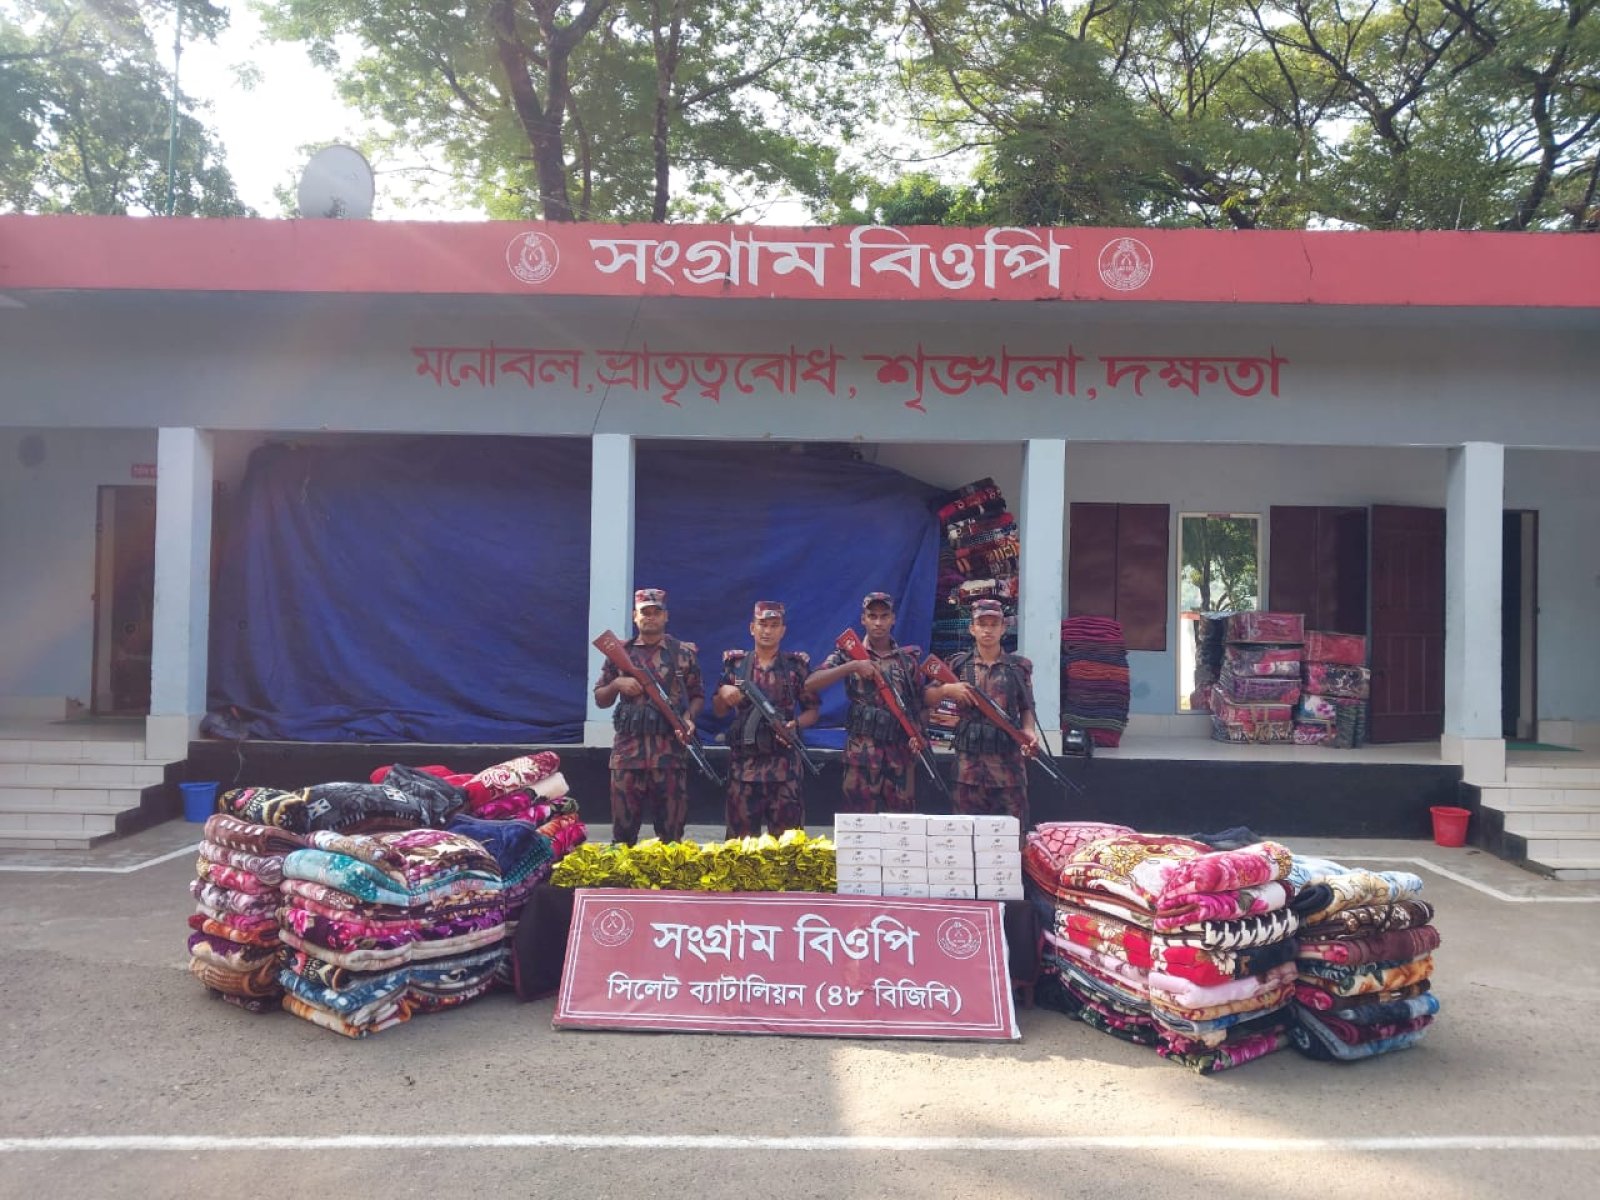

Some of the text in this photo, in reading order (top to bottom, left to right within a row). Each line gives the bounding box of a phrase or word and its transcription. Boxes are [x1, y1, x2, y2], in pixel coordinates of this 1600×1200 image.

[588, 224, 1071, 289] সংগ্রাম বিওপি
[1099, 345, 1291, 399] দক্ষতা
[650, 913, 921, 966] সংগ্রাম বিওপি
[607, 971, 963, 1016] সিলেট ব্যাটালিয়ন (৪৮ বিজিবি)
